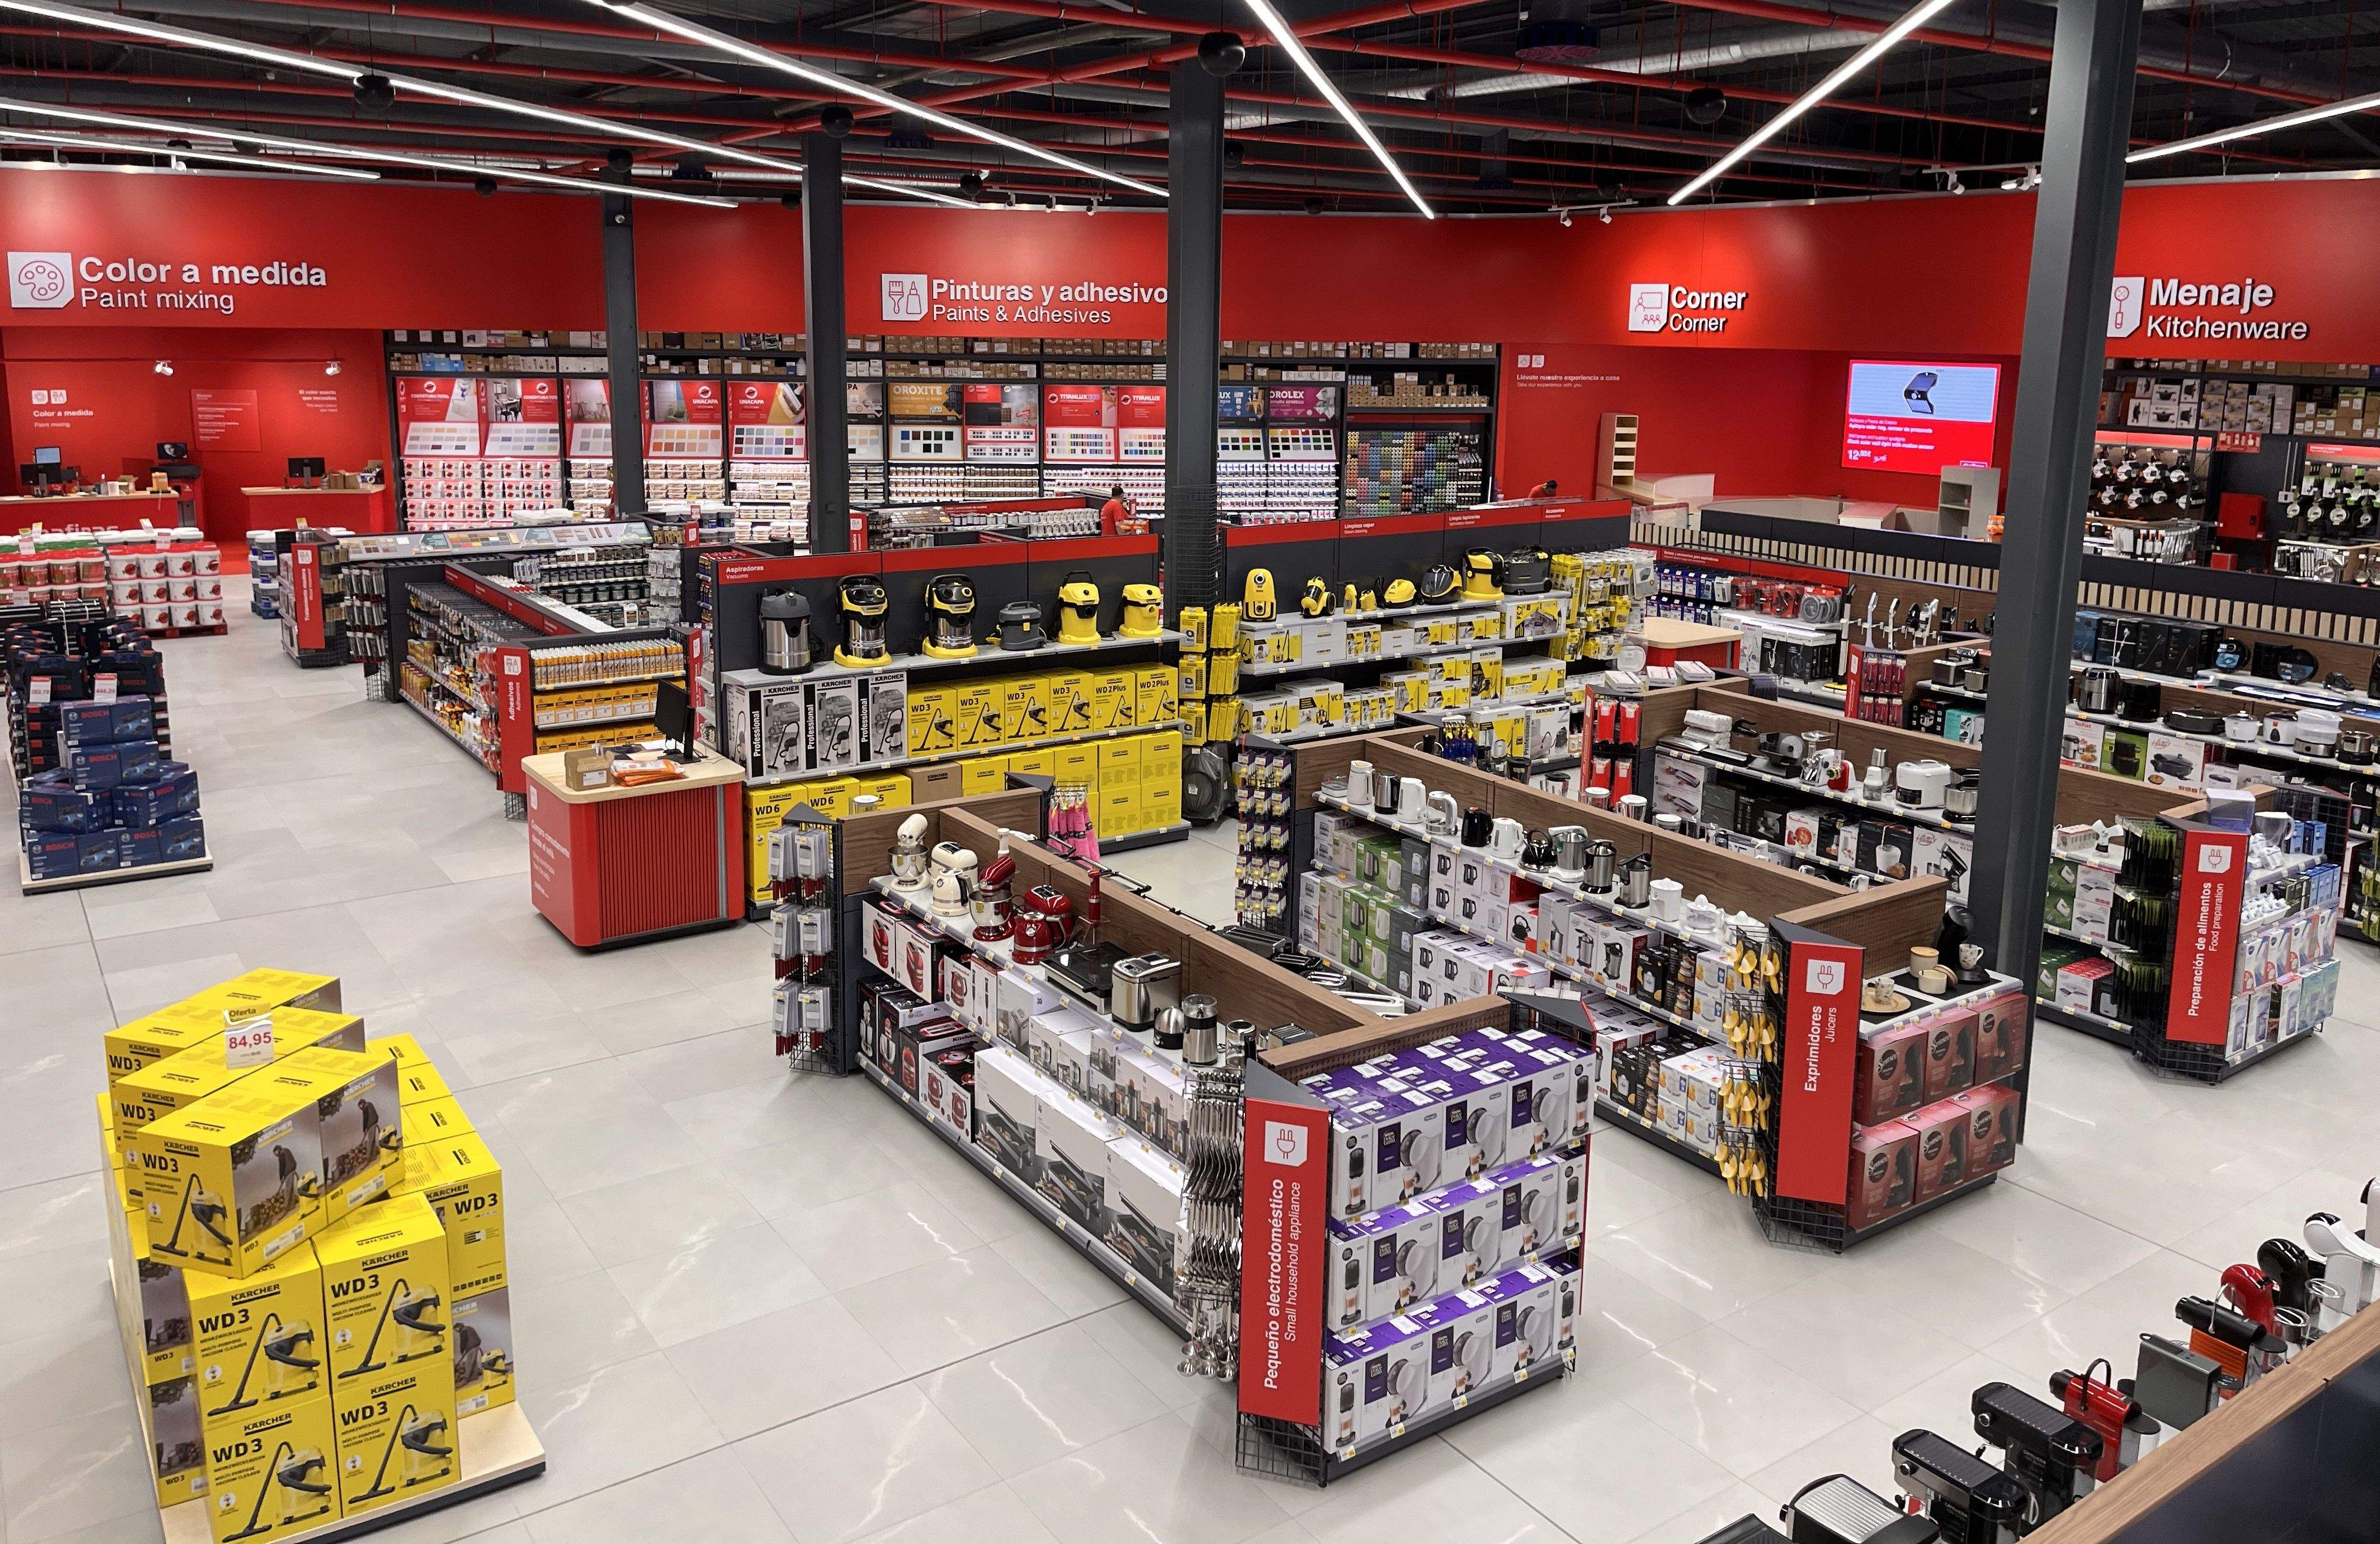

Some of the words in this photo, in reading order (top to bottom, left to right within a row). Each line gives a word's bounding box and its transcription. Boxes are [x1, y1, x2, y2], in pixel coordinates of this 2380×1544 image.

[79, 256, 171, 283] Color
[182, 264, 204, 283] a
[212, 261, 327, 286] medida
[81, 287, 148, 308] Paint
[156, 289, 234, 315] mixing
[933, 279, 1034, 301] Pinturas
[1041, 285, 1055, 306] y
[1060, 281, 1168, 303] adhesivo
[1670, 286, 1746, 309] Corner
[2150, 278, 2274, 314] Menaje
[933, 304, 990, 321] Paints
[995, 304, 1009, 322] &
[1013, 303, 1111, 323] Adhesives
[1669, 313, 1726, 332] Corner
[2147, 315, 2307, 340] Kitchenware
[892, 386, 943, 396] OROXITE
[725, 564, 764, 574] Aspiradoras
[1007, 693, 1019, 701] WD
[1052, 687, 1065, 696] WD
[1066, 686, 1070, 694] 3
[911, 705, 924, 713] WD
[925, 703, 931, 711] 3
[960, 698, 973, 707] WD
[80, 710, 109, 719] BOSCH
[753, 710, 761, 758] Professional
[89, 754, 117, 762] BOSCH
[31, 797, 53, 805] BOSCH
[755, 805, 773, 816] WD
[774, 804, 780, 813] 6
[810, 797, 826, 808] WD
[828, 795, 835, 805] 6
[133, 830, 162, 840] BOSCH
[45, 842, 74, 851] BOSCH
[2196, 882, 2212, 935] alimentos
[2212, 883, 2225, 929] preparation
[2195, 936, 2206, 951] de
[2208, 931, 2219, 952] Food
[2188, 952, 2205, 1017] Preparación
[228, 1007, 257, 1018] Oferta
[1825, 1007, 1838, 1043] Juicers
[228, 1031, 272, 1050] 84,95
[1804, 1006, 1823, 1092] Exprimidores
[109, 1054, 133, 1070] WD
[134, 1058, 142, 1071] 3
[121, 1102, 146, 1120] WD
[147, 1107, 156, 1122] 3
[142, 1152, 168, 1171] WD
[170, 1157, 179, 1173] 3
[454, 1196, 486, 1216] WD
[488, 1193, 498, 1207] 3
[1288, 1181, 1303, 1242] appliance
[1266, 1178, 1284, 1317] electrodoméstico
[1286, 1242, 1299, 1306] household
[331, 1278, 365, 1298] WD
[368, 1274, 380, 1289] 3
[198, 1311, 235, 1334] WD
[238, 1307, 250, 1324] 3
[1284, 1308, 1297, 1342] Small
[1264, 1320, 1282, 1389] Pequeño
[341, 1405, 375, 1426] WD
[377, 1401, 388, 1416] 3
[212, 1442, 249, 1463] WD
[251, 1438, 263, 1453] 3
